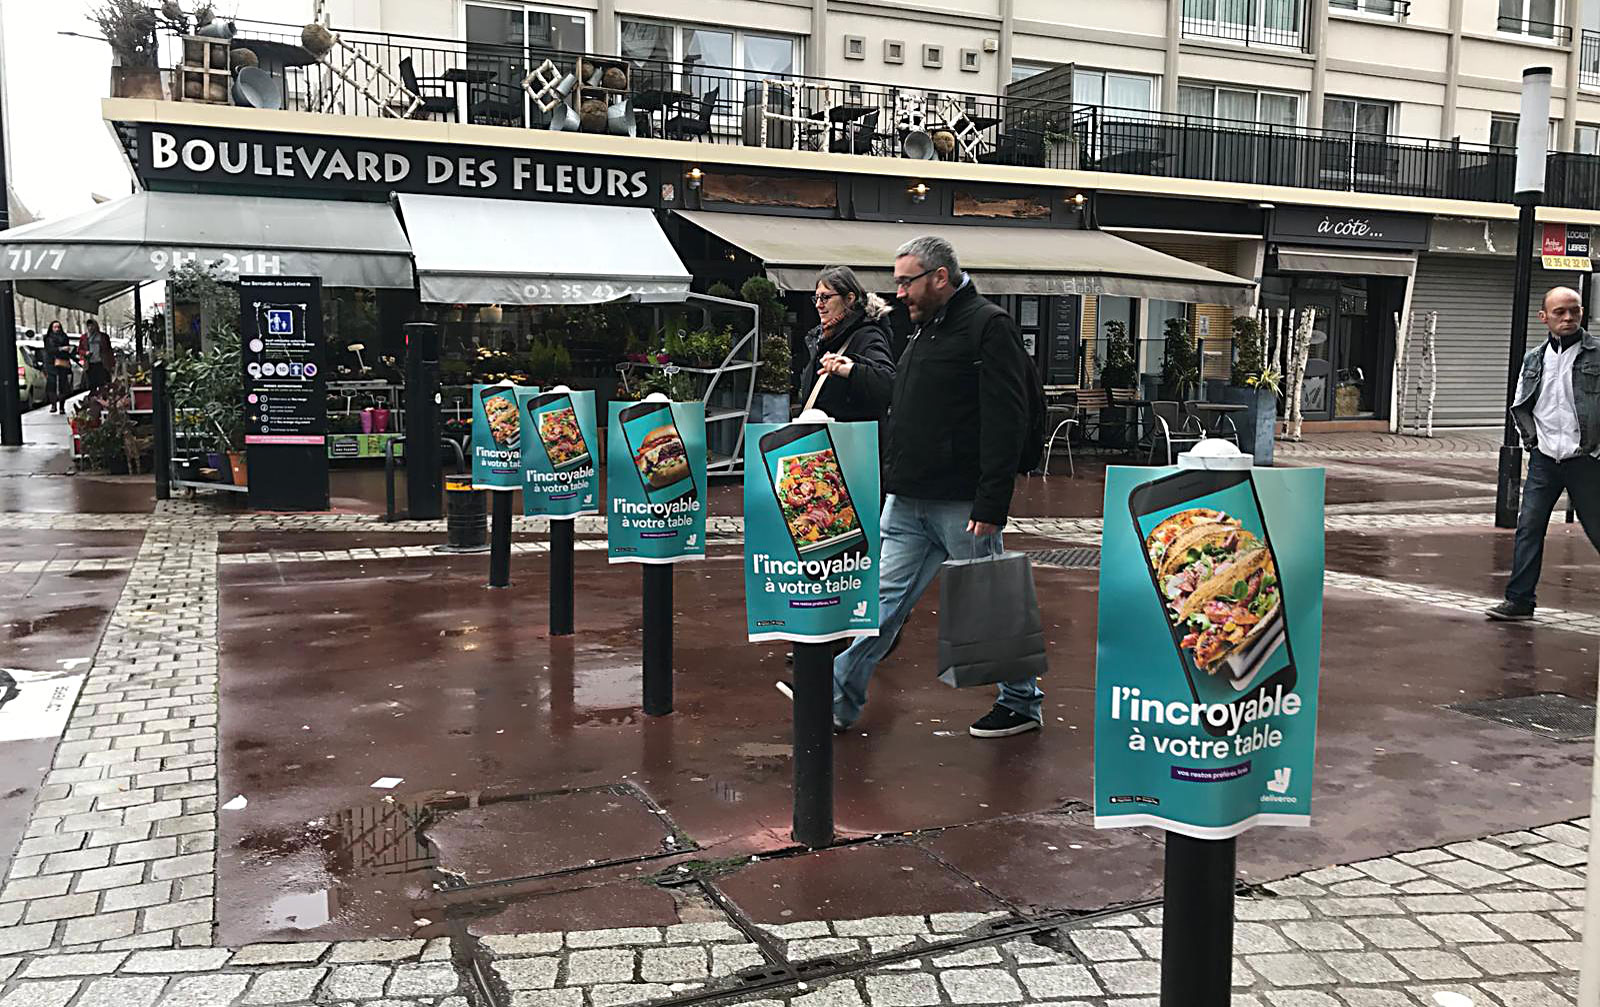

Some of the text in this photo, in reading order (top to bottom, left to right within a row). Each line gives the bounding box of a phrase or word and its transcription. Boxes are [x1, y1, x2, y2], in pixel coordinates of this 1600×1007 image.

[151, 131, 648, 199] BOULEVARD DES FLEURS
[1317, 216, 1334, 233] à
[1567, 244, 1588, 252] LIBRES
[523, 284, 552, 299] 02
[560, 284, 582, 299] 35
[487, 459, 508, 467] votre
[526, 466, 595, 483] l'incroyable
[534, 480, 589, 492] à votre table
[613, 497, 700, 518] l'incroyable
[622, 514, 693, 528] à votre table
[753, 551, 872, 580] l'incroyable
[765, 575, 861, 594] à votre table
[1111, 684, 1302, 737] l'incroyable
[1128, 724, 1283, 759] à votre table
[1259, 795, 1297, 803] deliveroo
